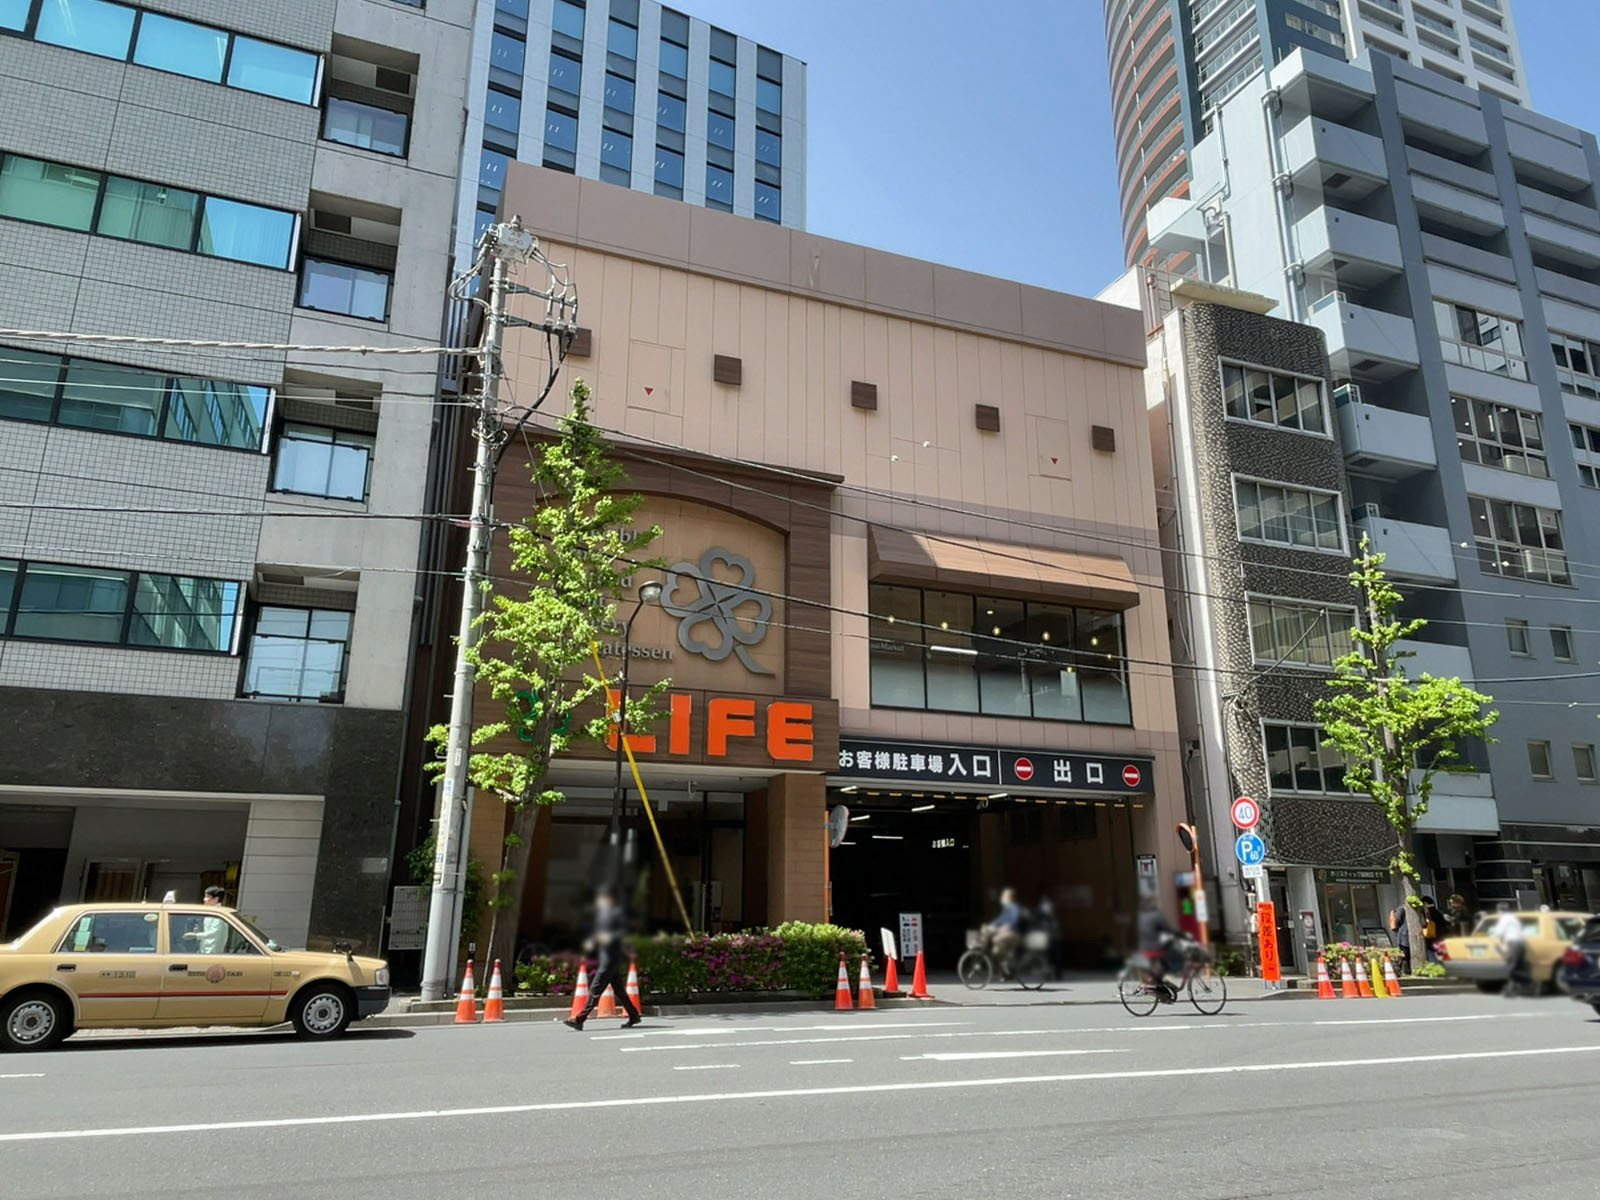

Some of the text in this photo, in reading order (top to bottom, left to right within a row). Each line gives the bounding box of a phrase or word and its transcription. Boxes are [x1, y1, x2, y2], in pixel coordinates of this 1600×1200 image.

[600, 641, 673, 660] atessen
[605, 689, 814, 761] LIFE
[1053, 759, 1104, 784] 出口
[1238, 806, 1253, 820] 40
[1241, 841, 1253, 861] P
